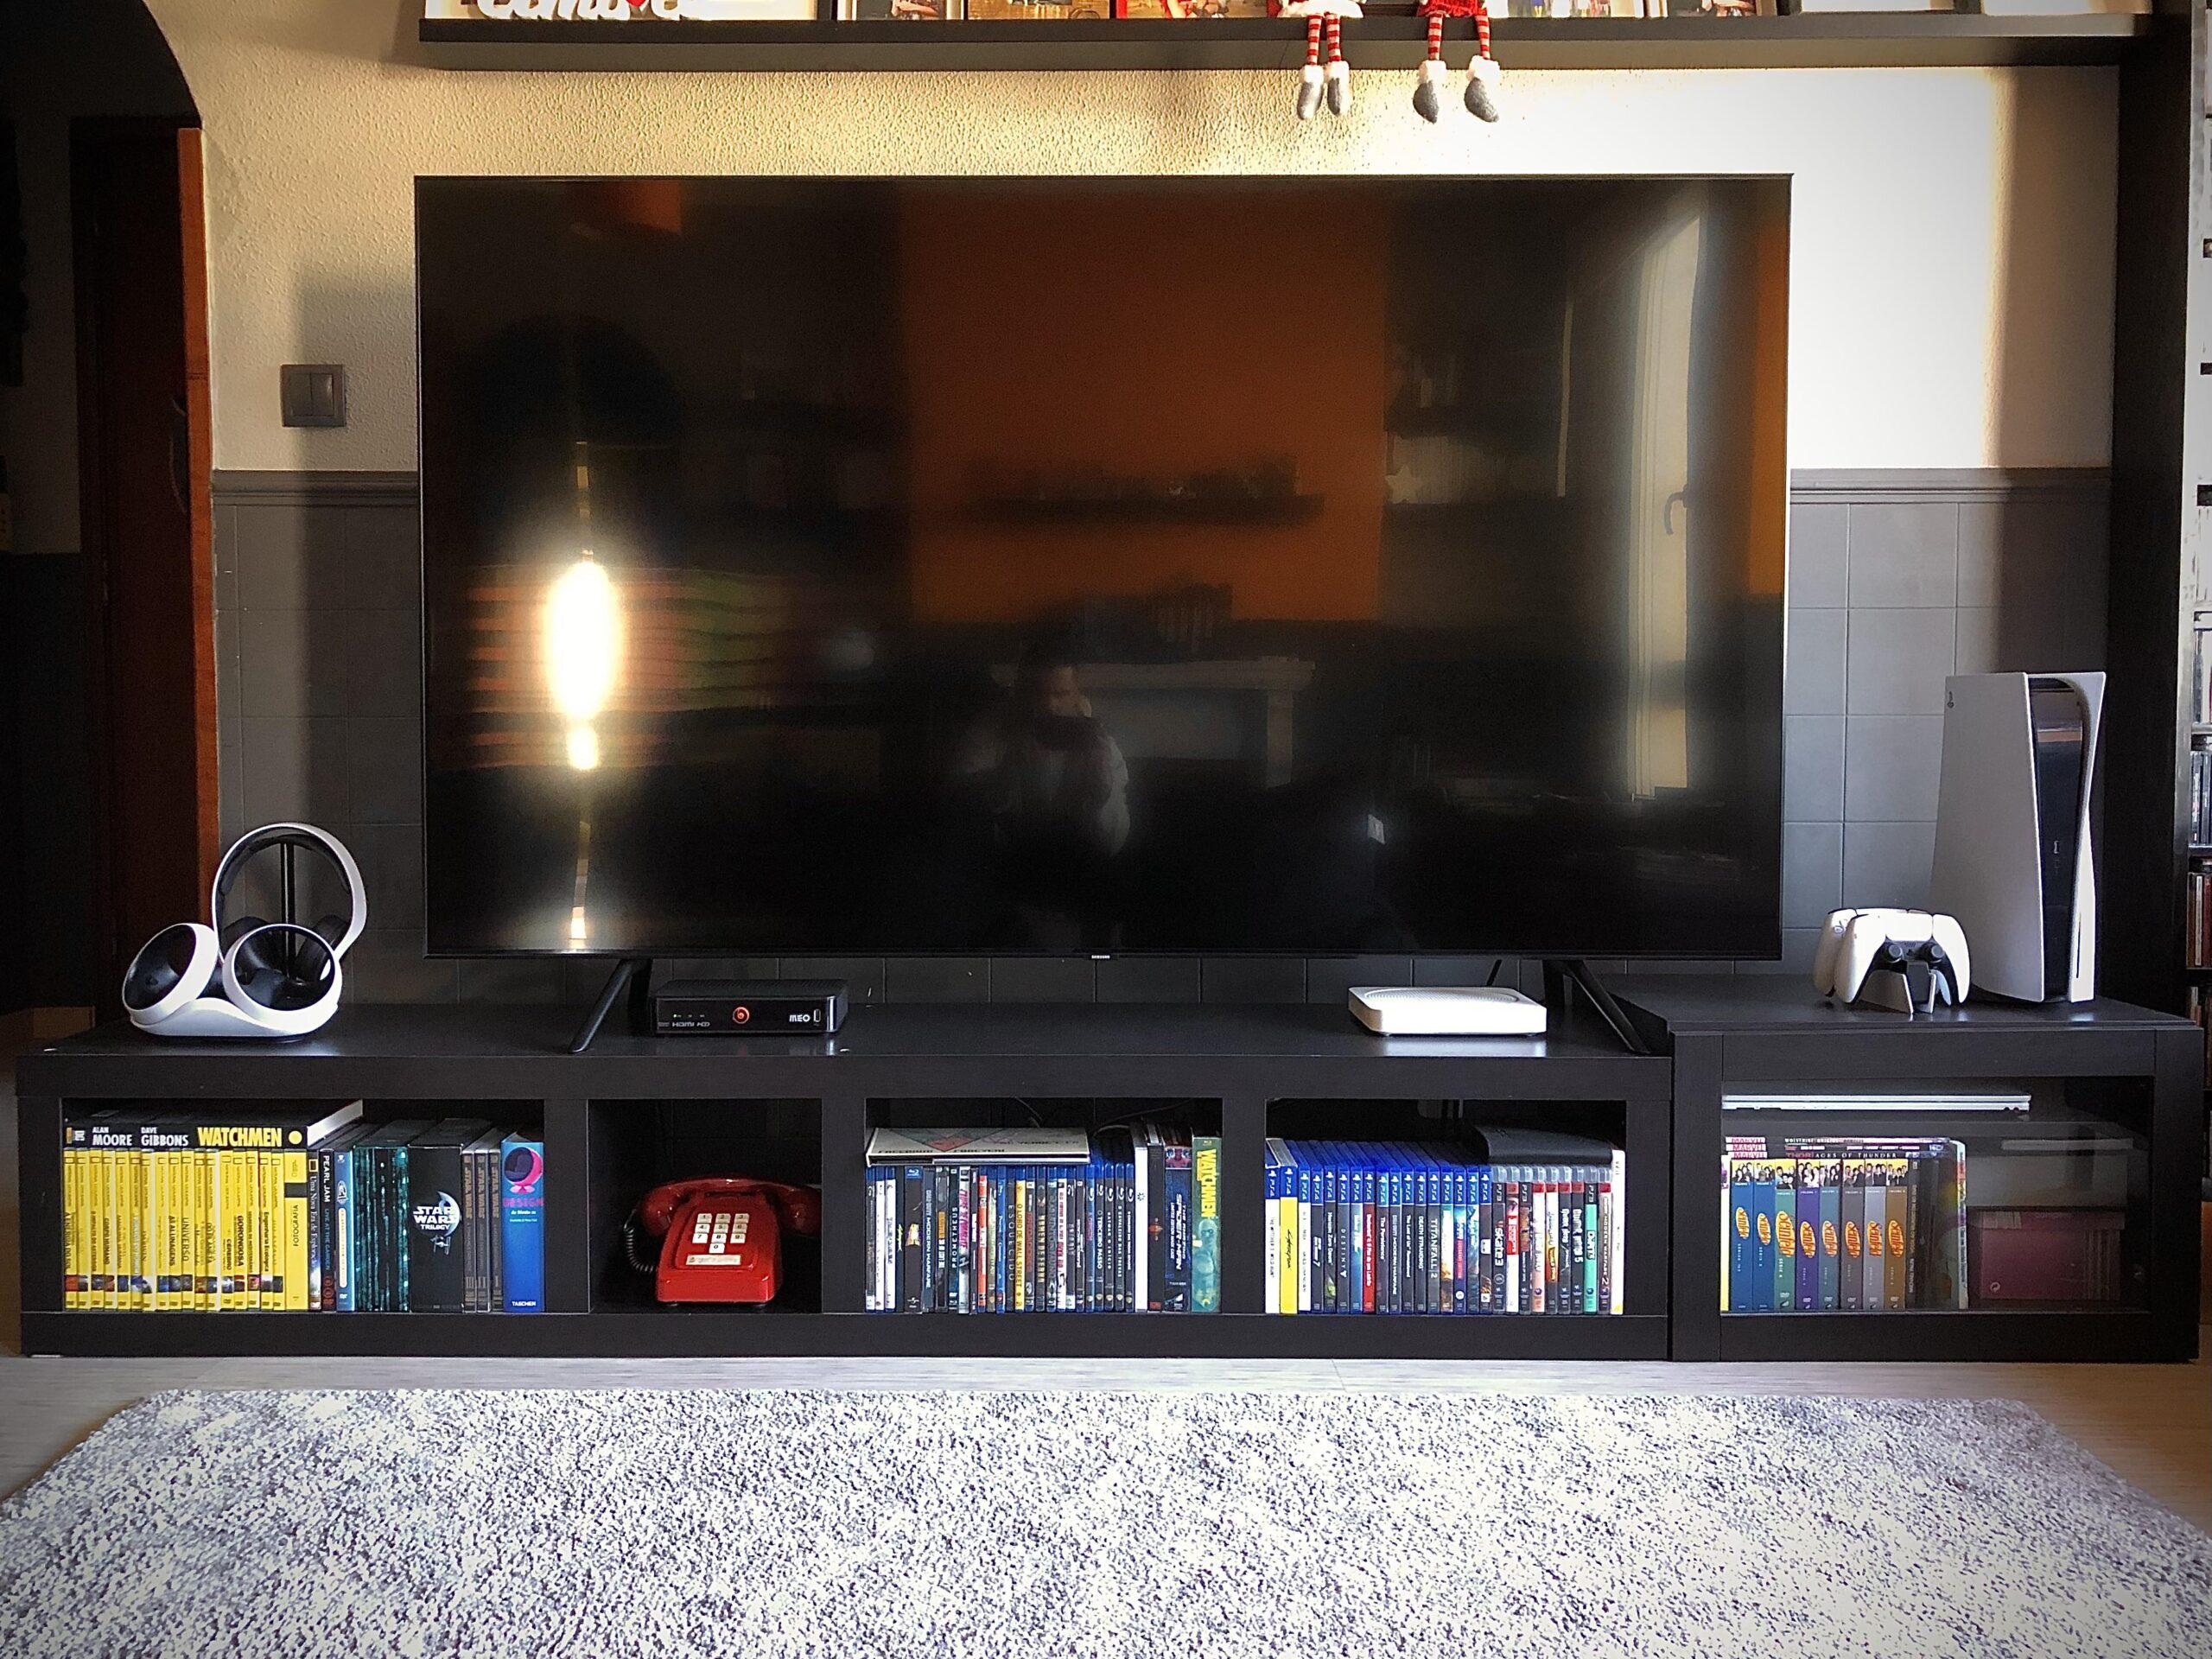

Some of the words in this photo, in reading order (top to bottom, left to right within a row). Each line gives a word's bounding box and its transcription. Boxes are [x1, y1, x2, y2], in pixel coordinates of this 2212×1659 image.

[92, 1135, 132, 1146] MOORE
[141, 1135, 188, 1146] GIBBONS
[197, 1128, 282, 1147] WATCHMEN
[1201, 1148, 1217, 1217] WATCHMEN
[413, 1206, 453, 1215] STAR
[414, 1215, 457, 1224] WARS
[1737, 1207, 1749, 1239] Seinfeld
[1017, 1230, 1022, 1239] DE
[1758, 1214, 1770, 1245] Seinfeld
[1777, 1211, 1794, 1257] Seinfeld
[1801, 1223, 1815, 1258] Seinfeld
[1823, 1222, 1838, 1257] Seinfeld
[1847, 1223, 1859, 1258] Seinfeld
[1870, 1221, 1882, 1256] Seinfeld
[1889, 1222, 1904, 1257] Seinfeld
